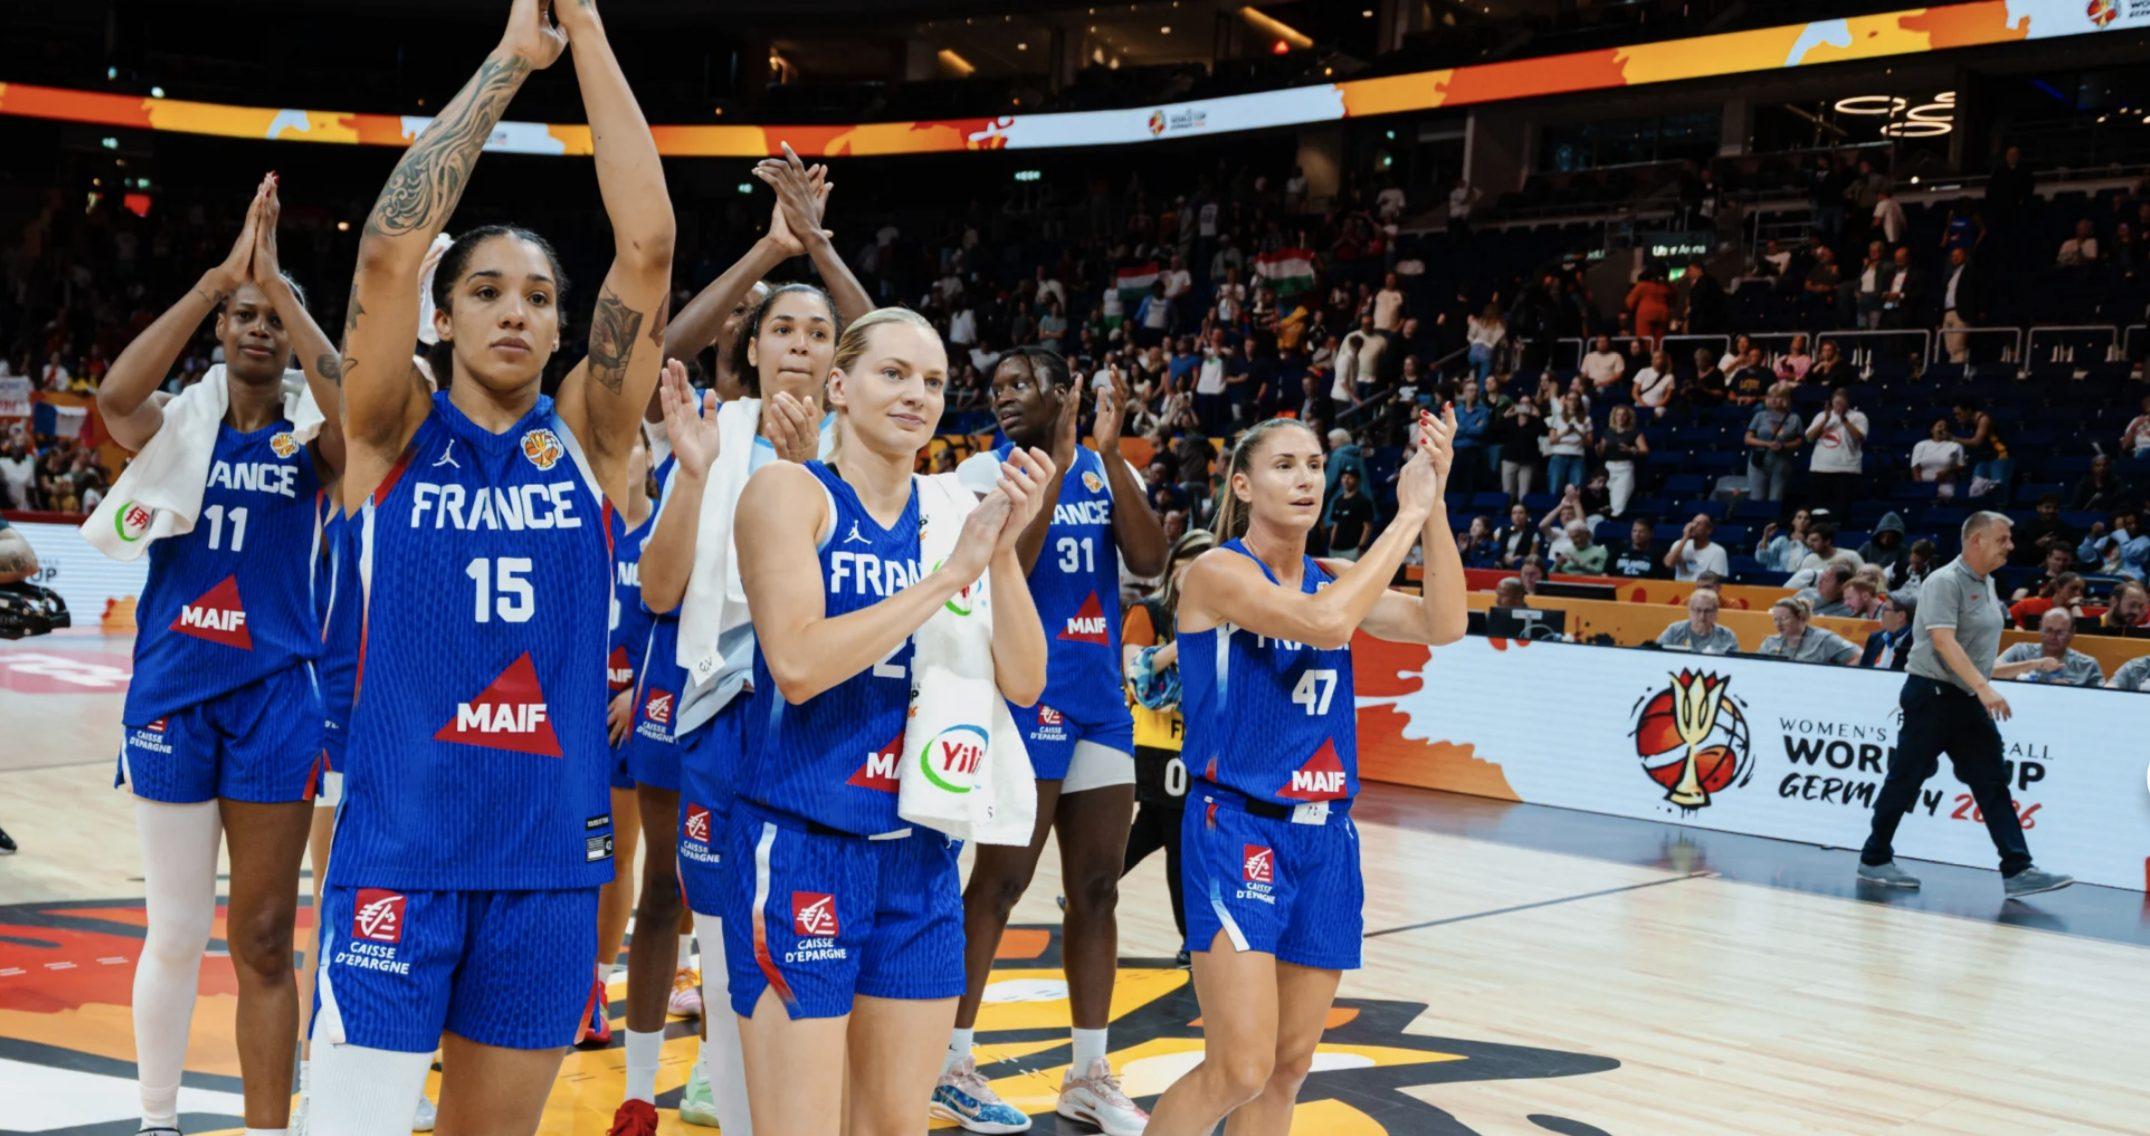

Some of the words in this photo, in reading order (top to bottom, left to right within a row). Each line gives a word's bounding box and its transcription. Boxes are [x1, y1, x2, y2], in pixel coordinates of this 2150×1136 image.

[207, 460, 298, 498] ANCE
[411, 481, 581, 530] FRANCE
[1050, 500, 1111, 525] ANCE
[204, 504, 247, 552] 11
[1057, 537, 1094, 573] 31
[30, 567, 57, 582] UP
[465, 557, 535, 623] 15
[180, 604, 246, 631] MAIF
[1067, 617, 1107, 635] MAIF
[608, 668, 633, 682] AIF
[1292, 669, 1338, 715] 47
[457, 703, 547, 733] MAIF
[1779, 717, 1887, 742] WOMEN'S
[129, 736, 173, 754] D'EPARGNE
[136, 730, 163, 743] CAISSE
[942, 741, 983, 775] Yili
[1291, 771, 1346, 793] MAIF
[1778, 772, 1943, 817] GERMY
[350, 941, 396, 959] CAISSE
[785, 948, 847, 963] D'EPARGNE
[797, 938, 834, 950] CAISSE
[334, 952, 410, 975] D'EPARGNE
